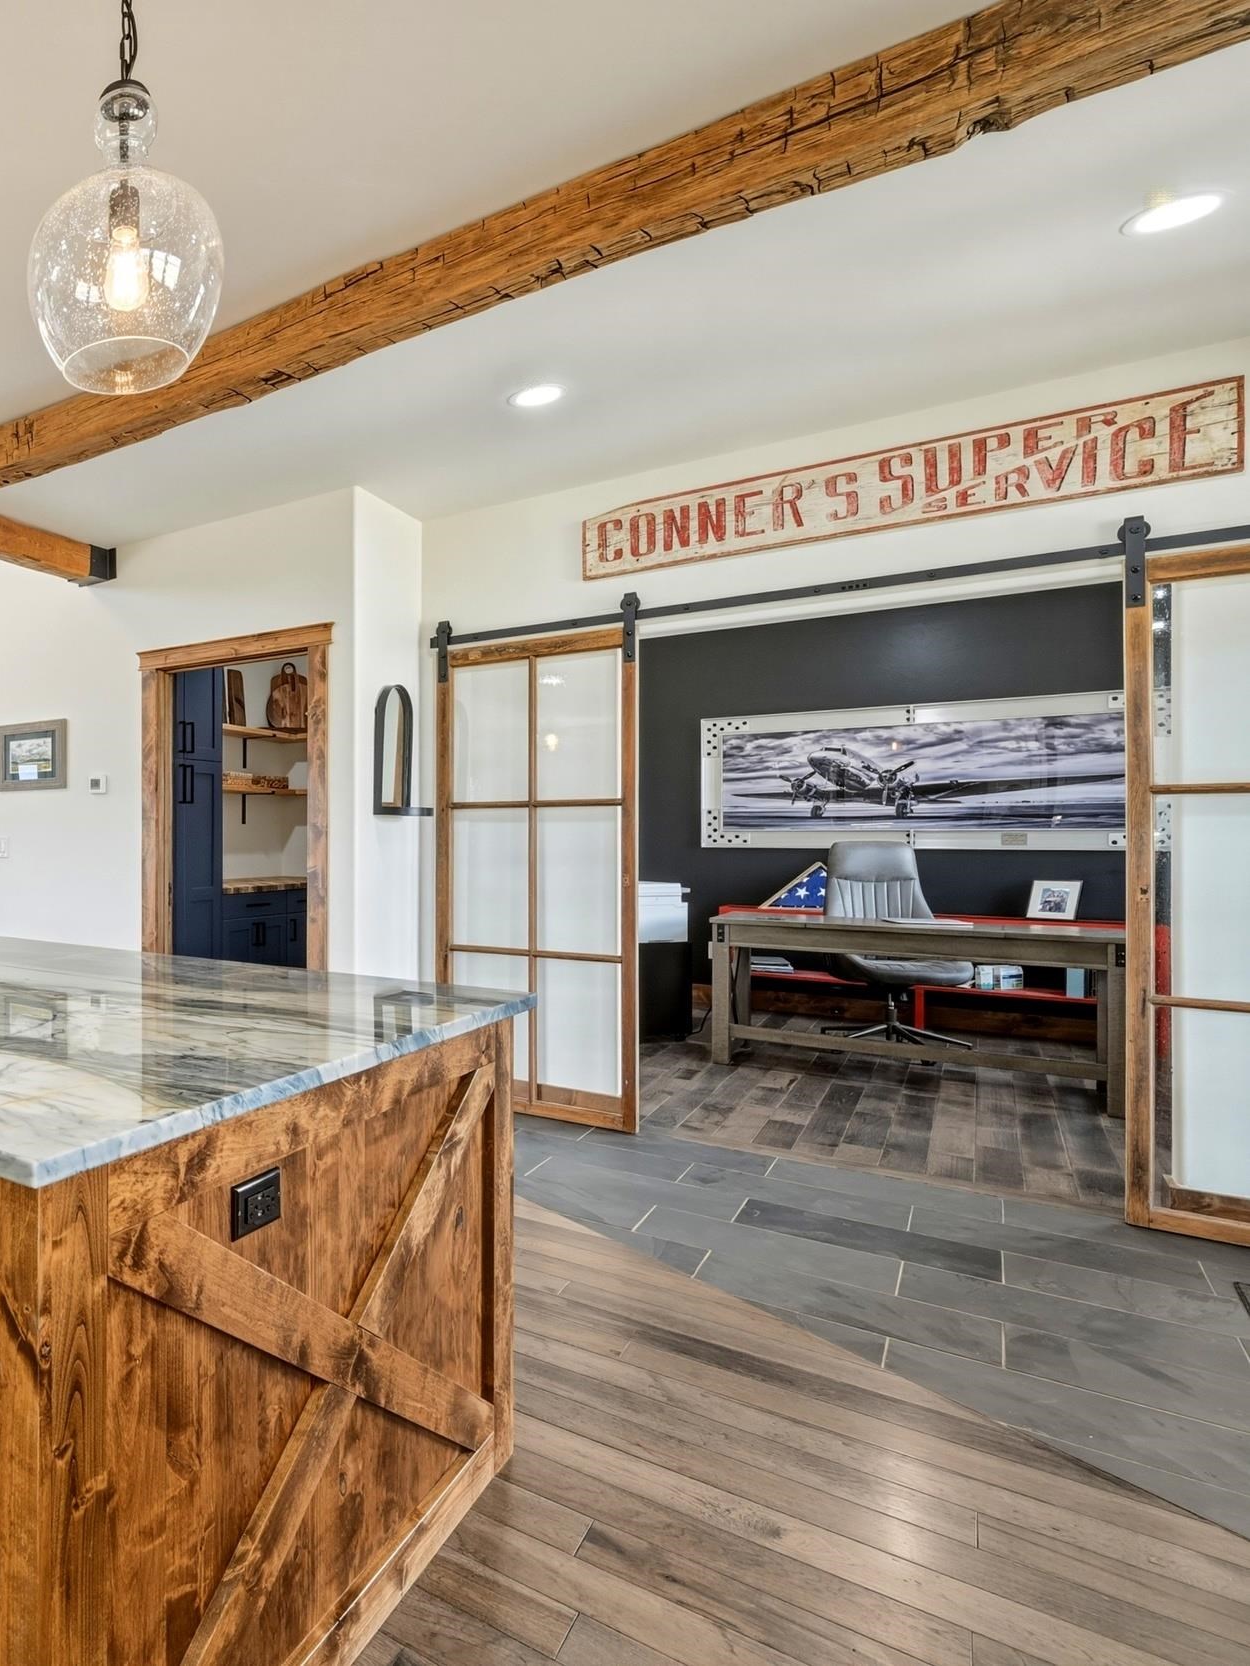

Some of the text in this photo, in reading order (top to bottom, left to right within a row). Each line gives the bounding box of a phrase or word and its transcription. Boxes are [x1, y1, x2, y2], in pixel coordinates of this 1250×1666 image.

[597, 410, 1118, 563] CONNER'S SUPER
[921, 389, 1216, 514] SERVICE
